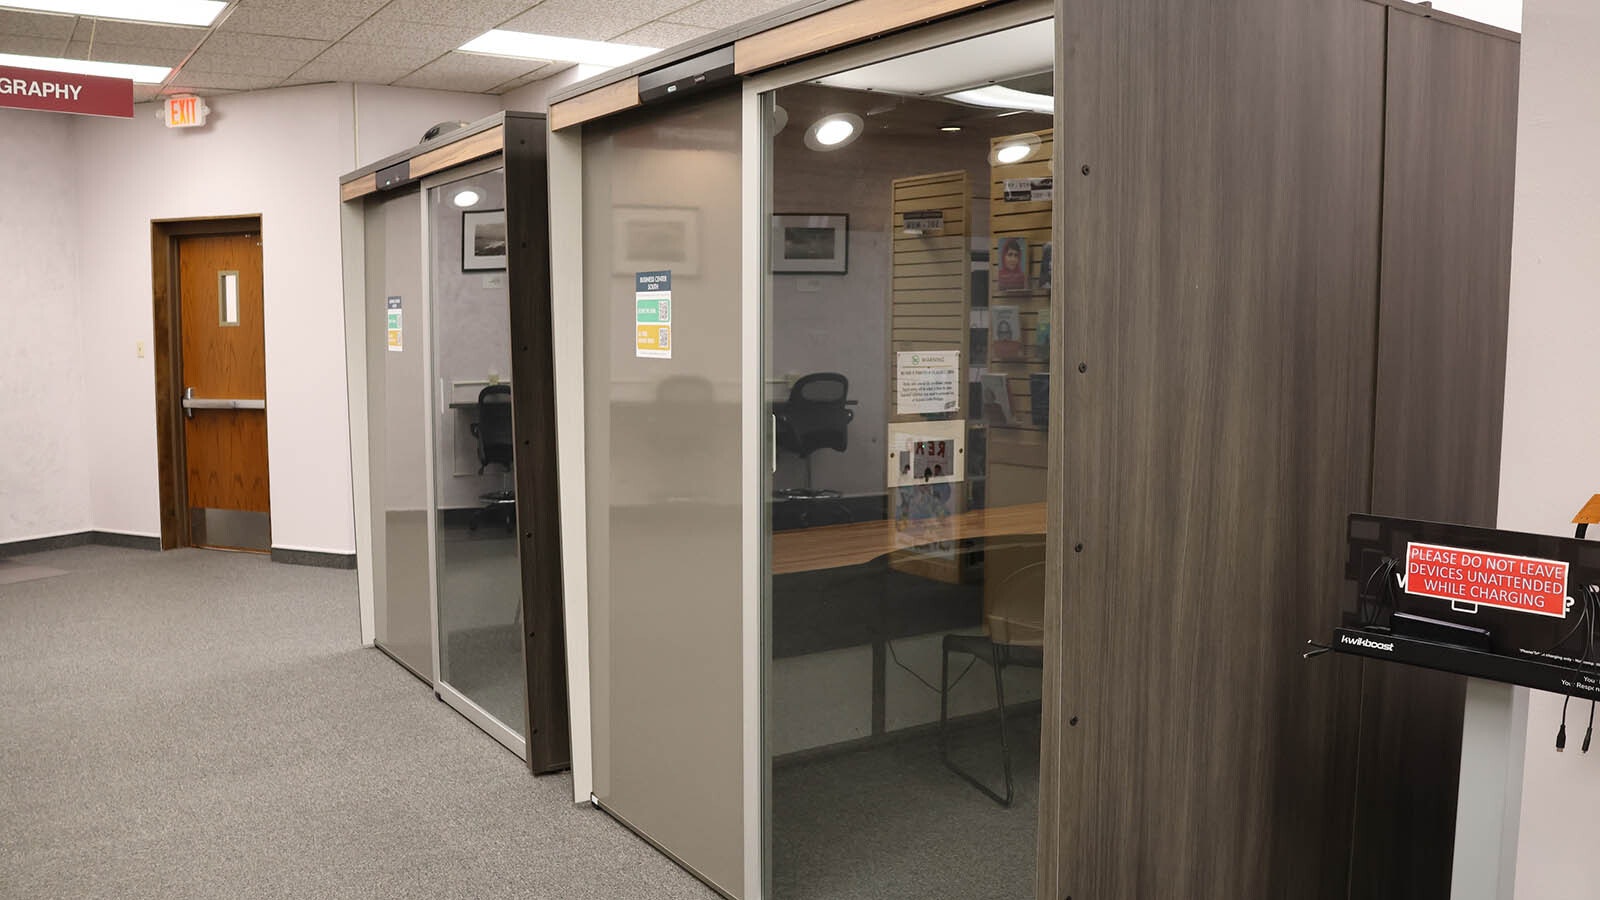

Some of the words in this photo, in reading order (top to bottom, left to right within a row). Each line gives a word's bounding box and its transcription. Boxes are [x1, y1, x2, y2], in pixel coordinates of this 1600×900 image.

[170, 98, 197, 126] EXIT
[1410, 562, 1463, 581] DEVICES
[1468, 571, 1563, 595] UNATTENDED
[1411, 548, 1457, 565] PLEASE
[1461, 555, 1482, 568] DO
[1486, 559, 1514, 572] NOT
[1520, 563, 1563, 580] LEAVE
[1424, 579, 1466, 596] WHILE
[1470, 586, 1545, 608] CHARGING
